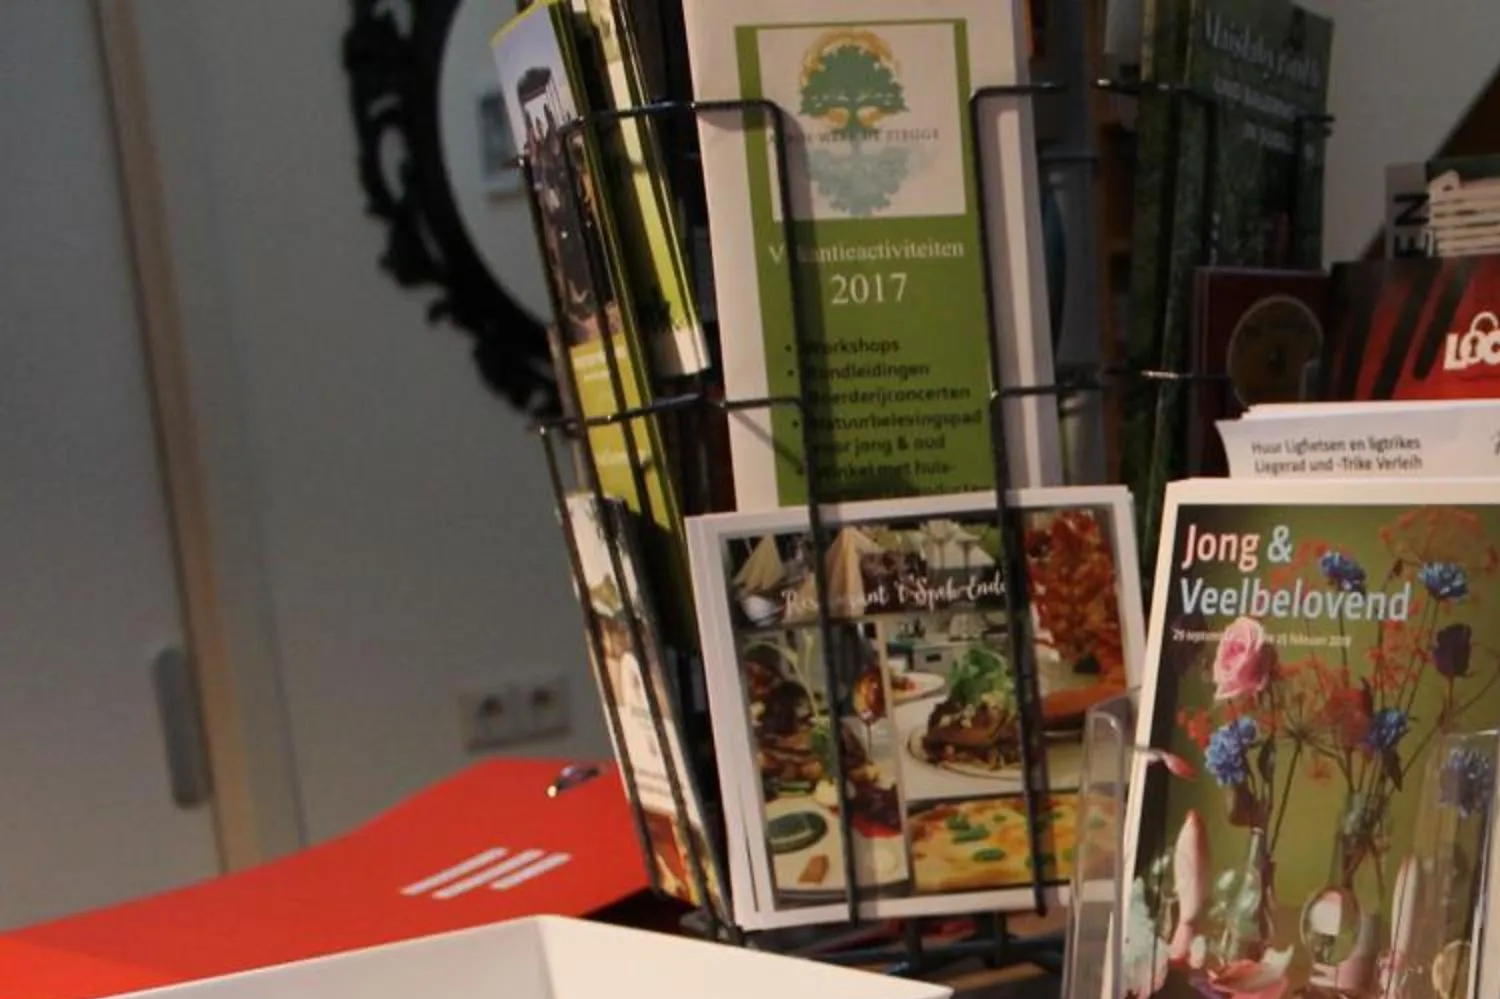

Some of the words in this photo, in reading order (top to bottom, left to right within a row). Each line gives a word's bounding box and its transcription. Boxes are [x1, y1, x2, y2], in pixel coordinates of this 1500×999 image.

[769, 239, 965, 265] Vkantieactiviteiten
[831, 271, 908, 305] 2017
[1350, 441, 1366, 452] en
[1310, 457, 1333, 471] und
[1181, 524, 1260, 572] Jong
[1267, 525, 1293, 562] &
[1180, 577, 1413, 622] Veelbelovend
